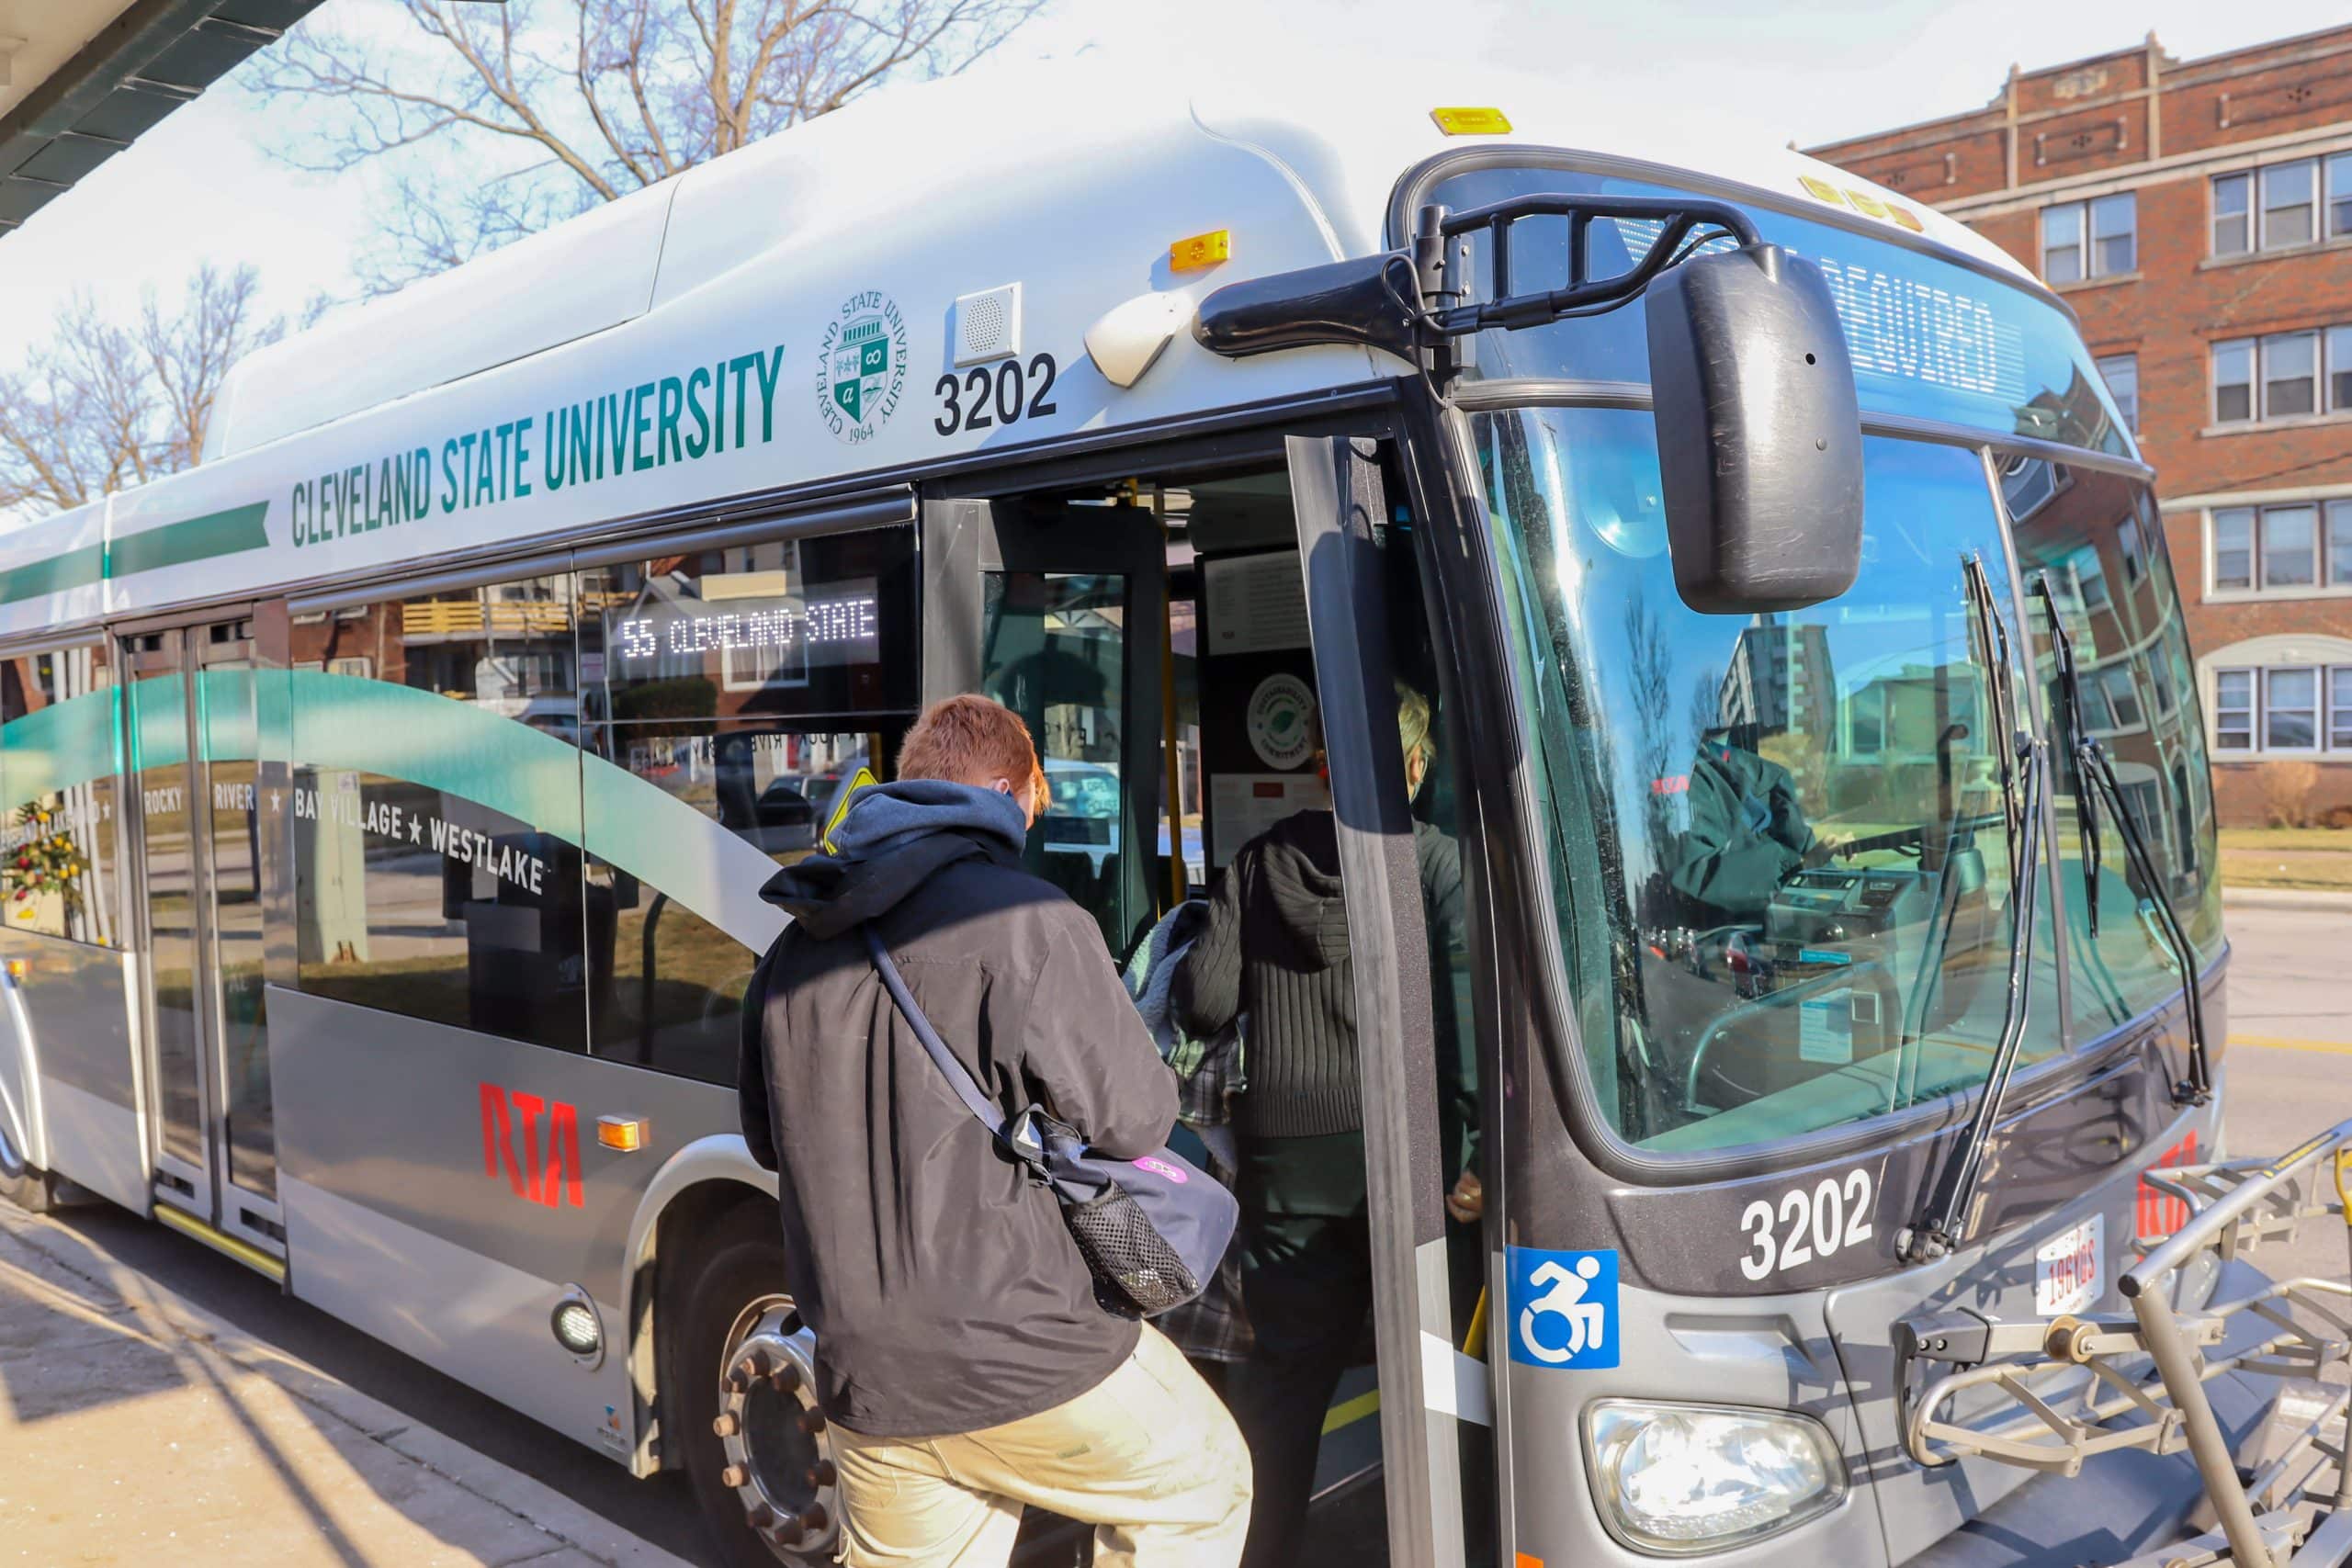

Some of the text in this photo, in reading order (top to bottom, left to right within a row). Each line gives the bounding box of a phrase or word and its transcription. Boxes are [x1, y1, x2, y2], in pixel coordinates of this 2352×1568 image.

[816, 291, 908, 435] CLEVELAND STATE UNIVERSITY
[933, 353, 1057, 436] 3202
[291, 344, 786, 547] CLEVELAND STATE UNIVERSITY
[849, 423, 874, 446] 1964
[622, 599, 875, 660] 55 CLEVELAND STATE
[143, 785, 182, 816] ROCKY
[214, 783, 254, 811] RIVER
[294, 787, 324, 819] BAY
[330, 793, 402, 839] VILLAGE
[430, 817, 544, 896] WESTLAKE
[479, 1081, 585, 1209] RTA
[1739, 1168, 1874, 1281] 3202
